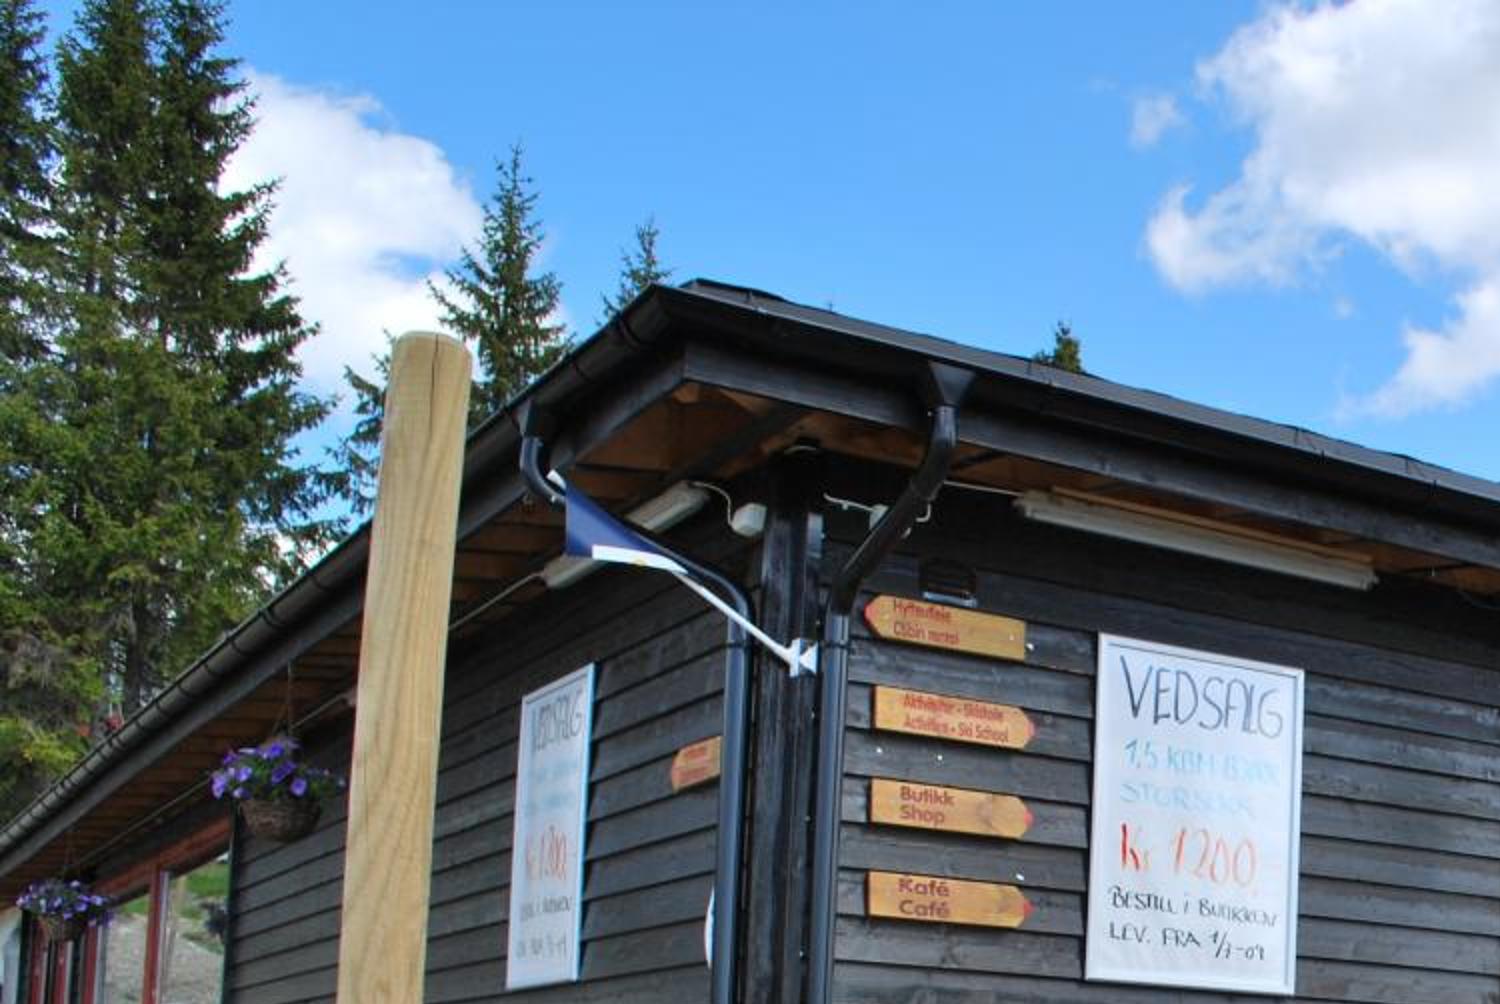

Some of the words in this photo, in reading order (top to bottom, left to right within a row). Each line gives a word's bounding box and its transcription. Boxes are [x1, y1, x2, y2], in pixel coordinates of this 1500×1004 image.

[1120, 655, 1283, 739] VEDSALG
[900, 785, 955, 806] Butikk
[899, 804, 945, 825] Shop
[1173, 826, 1258, 888] 1200
[899, 878, 950, 897] Kafé
[899, 899, 951, 918] Café
[1161, 927, 1202, 948] FRA
